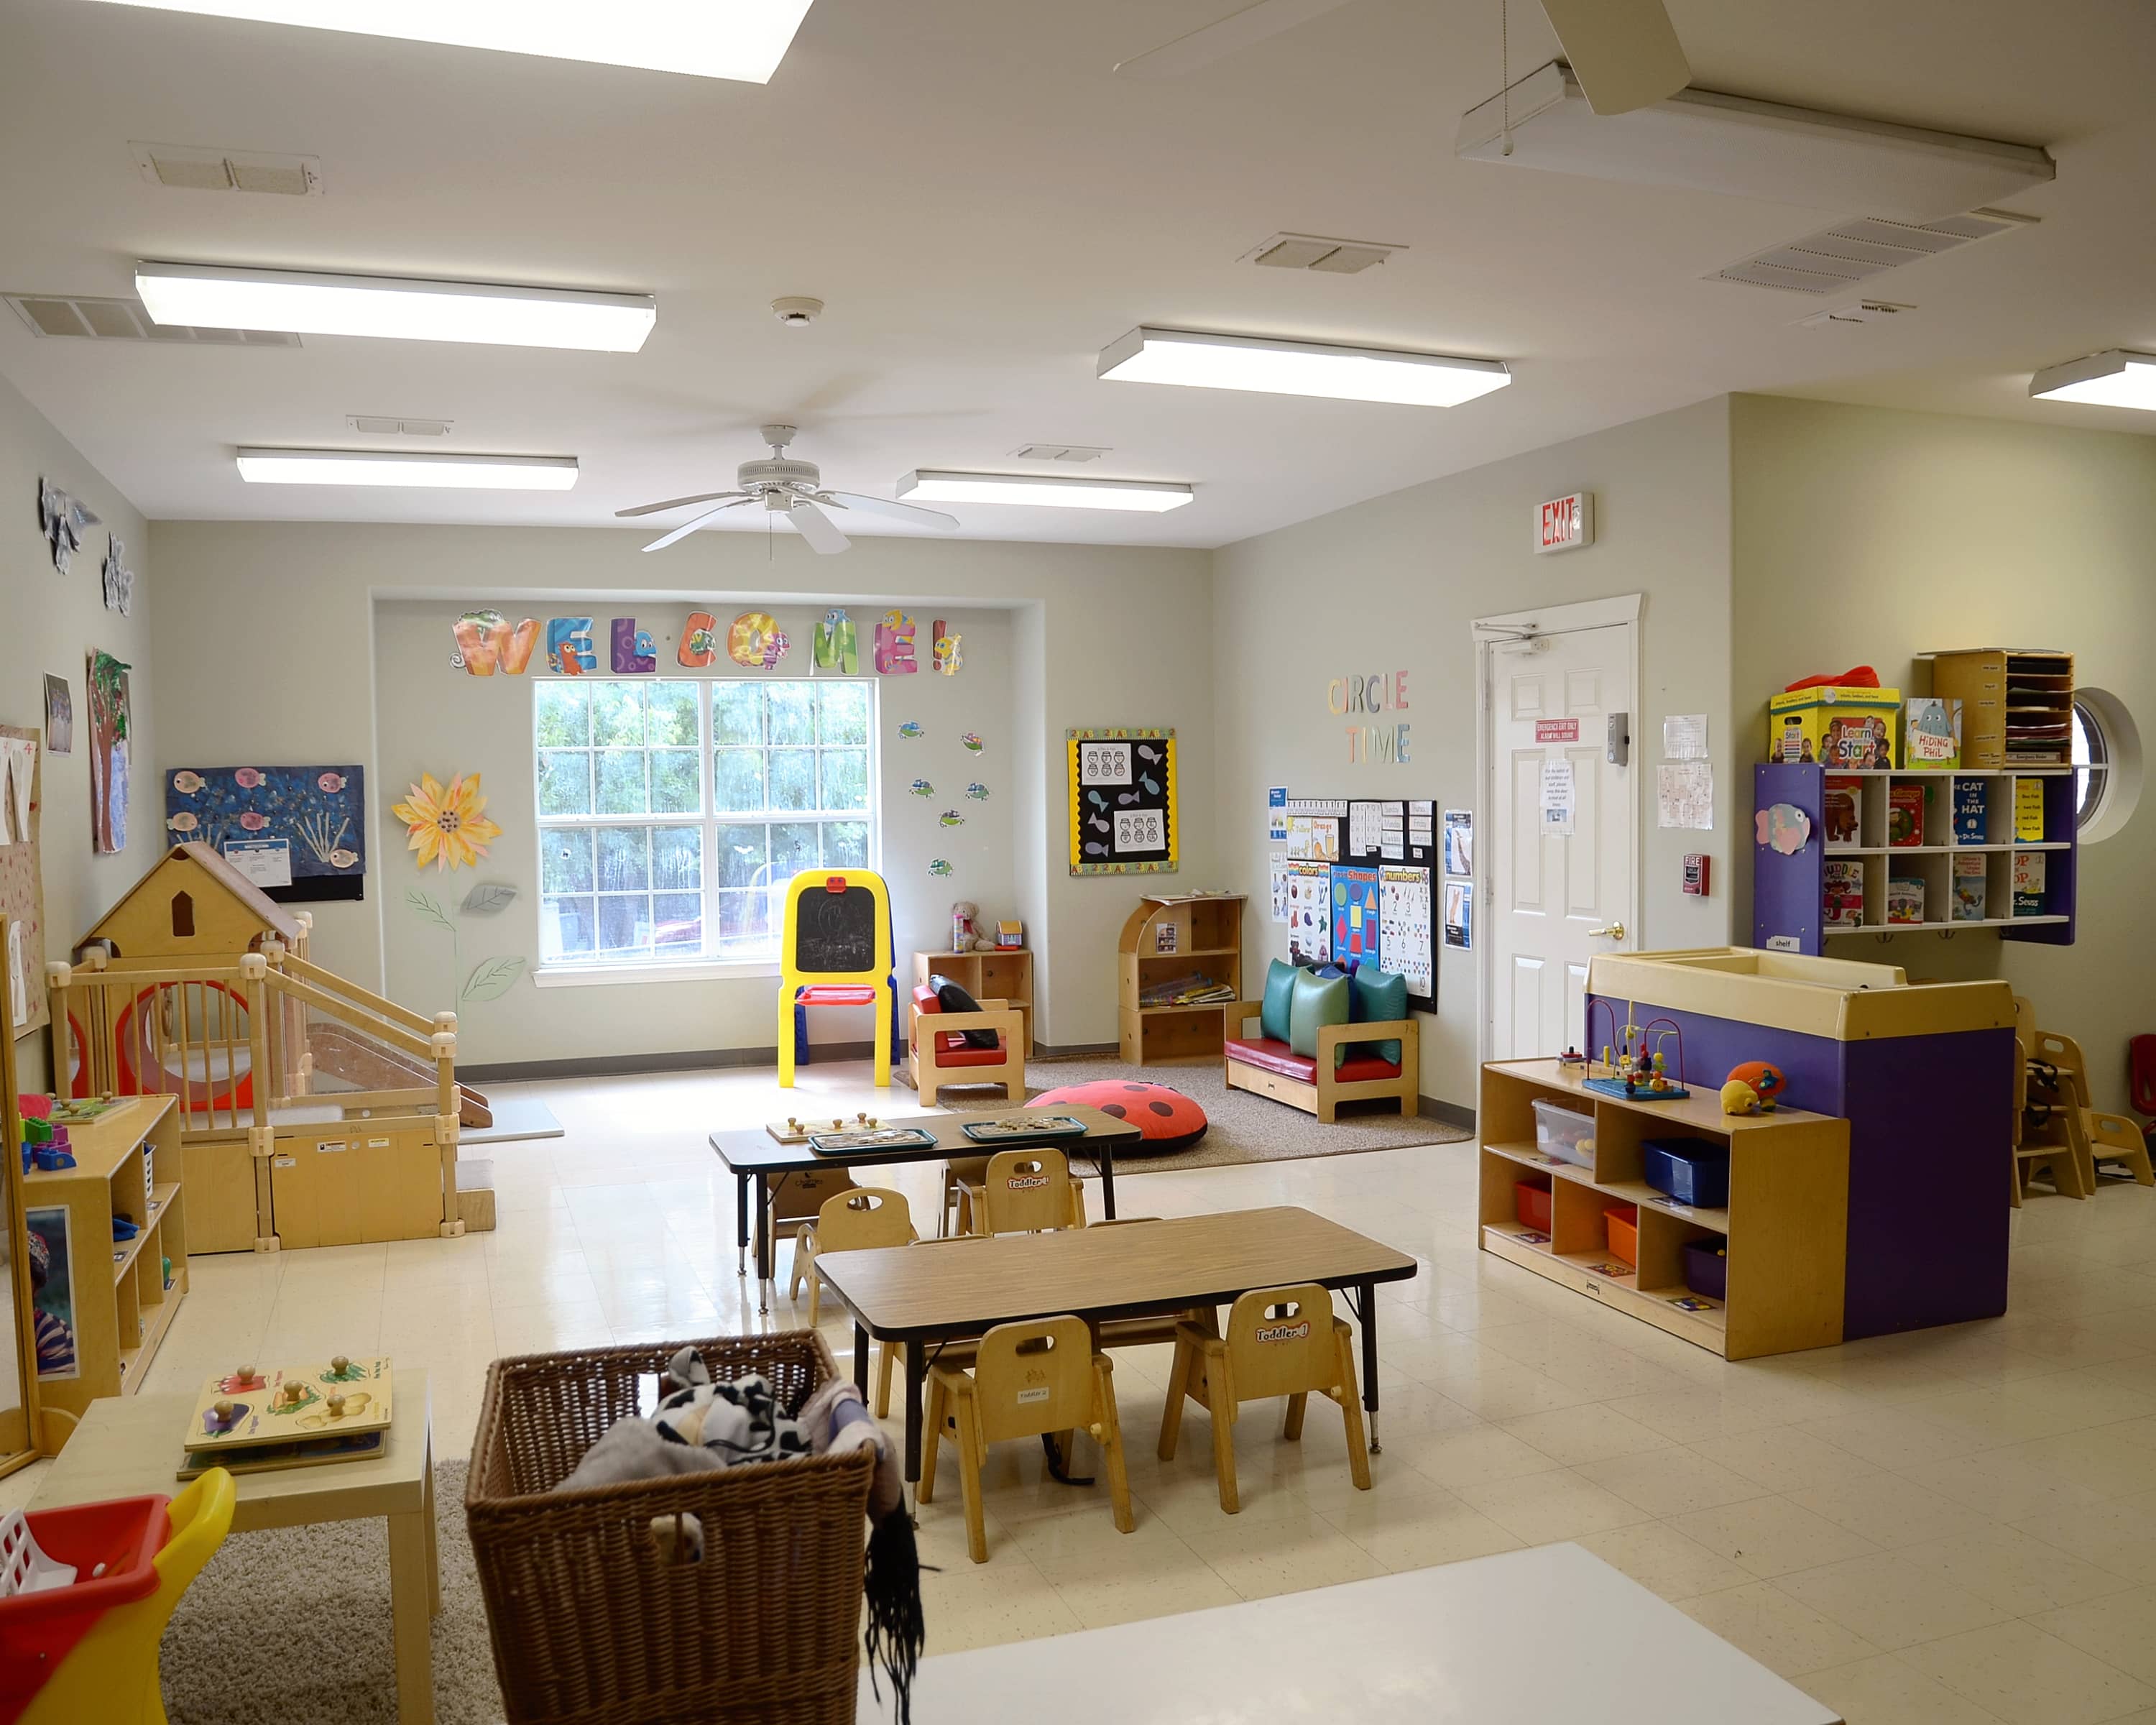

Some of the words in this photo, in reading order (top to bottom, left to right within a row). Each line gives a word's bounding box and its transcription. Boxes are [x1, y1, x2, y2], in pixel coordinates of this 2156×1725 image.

[1542, 497, 1574, 546] EXIT
[1327, 670, 1409, 716] CIRCLE
[1842, 726, 1871, 739] Learn
[24, 742, 32, 755] 4
[1345, 724, 1410, 764] TIME
[1838, 740, 1875, 758] Start
[1962, 782, 1984, 791] CAT
[1961, 805, 1985, 814] HAT
[1313, 820, 1332, 833] Orange
[1685, 857, 1700, 865] FIRE
[1299, 863, 1319, 876] colors
[1348, 870, 1377, 882] Shapes
[1386, 868, 1421, 883] numbers
[1393, 901, 1397, 911] 2
[1406, 902, 1411, 913] 3
[2018, 896, 2039, 906] Seuss
[1401, 938, 1406, 949] 6
[1419, 941, 1424, 951] 7
[1010, 1178, 1041, 1187] Toddler
[1258, 1328, 1296, 1340] Toddler
